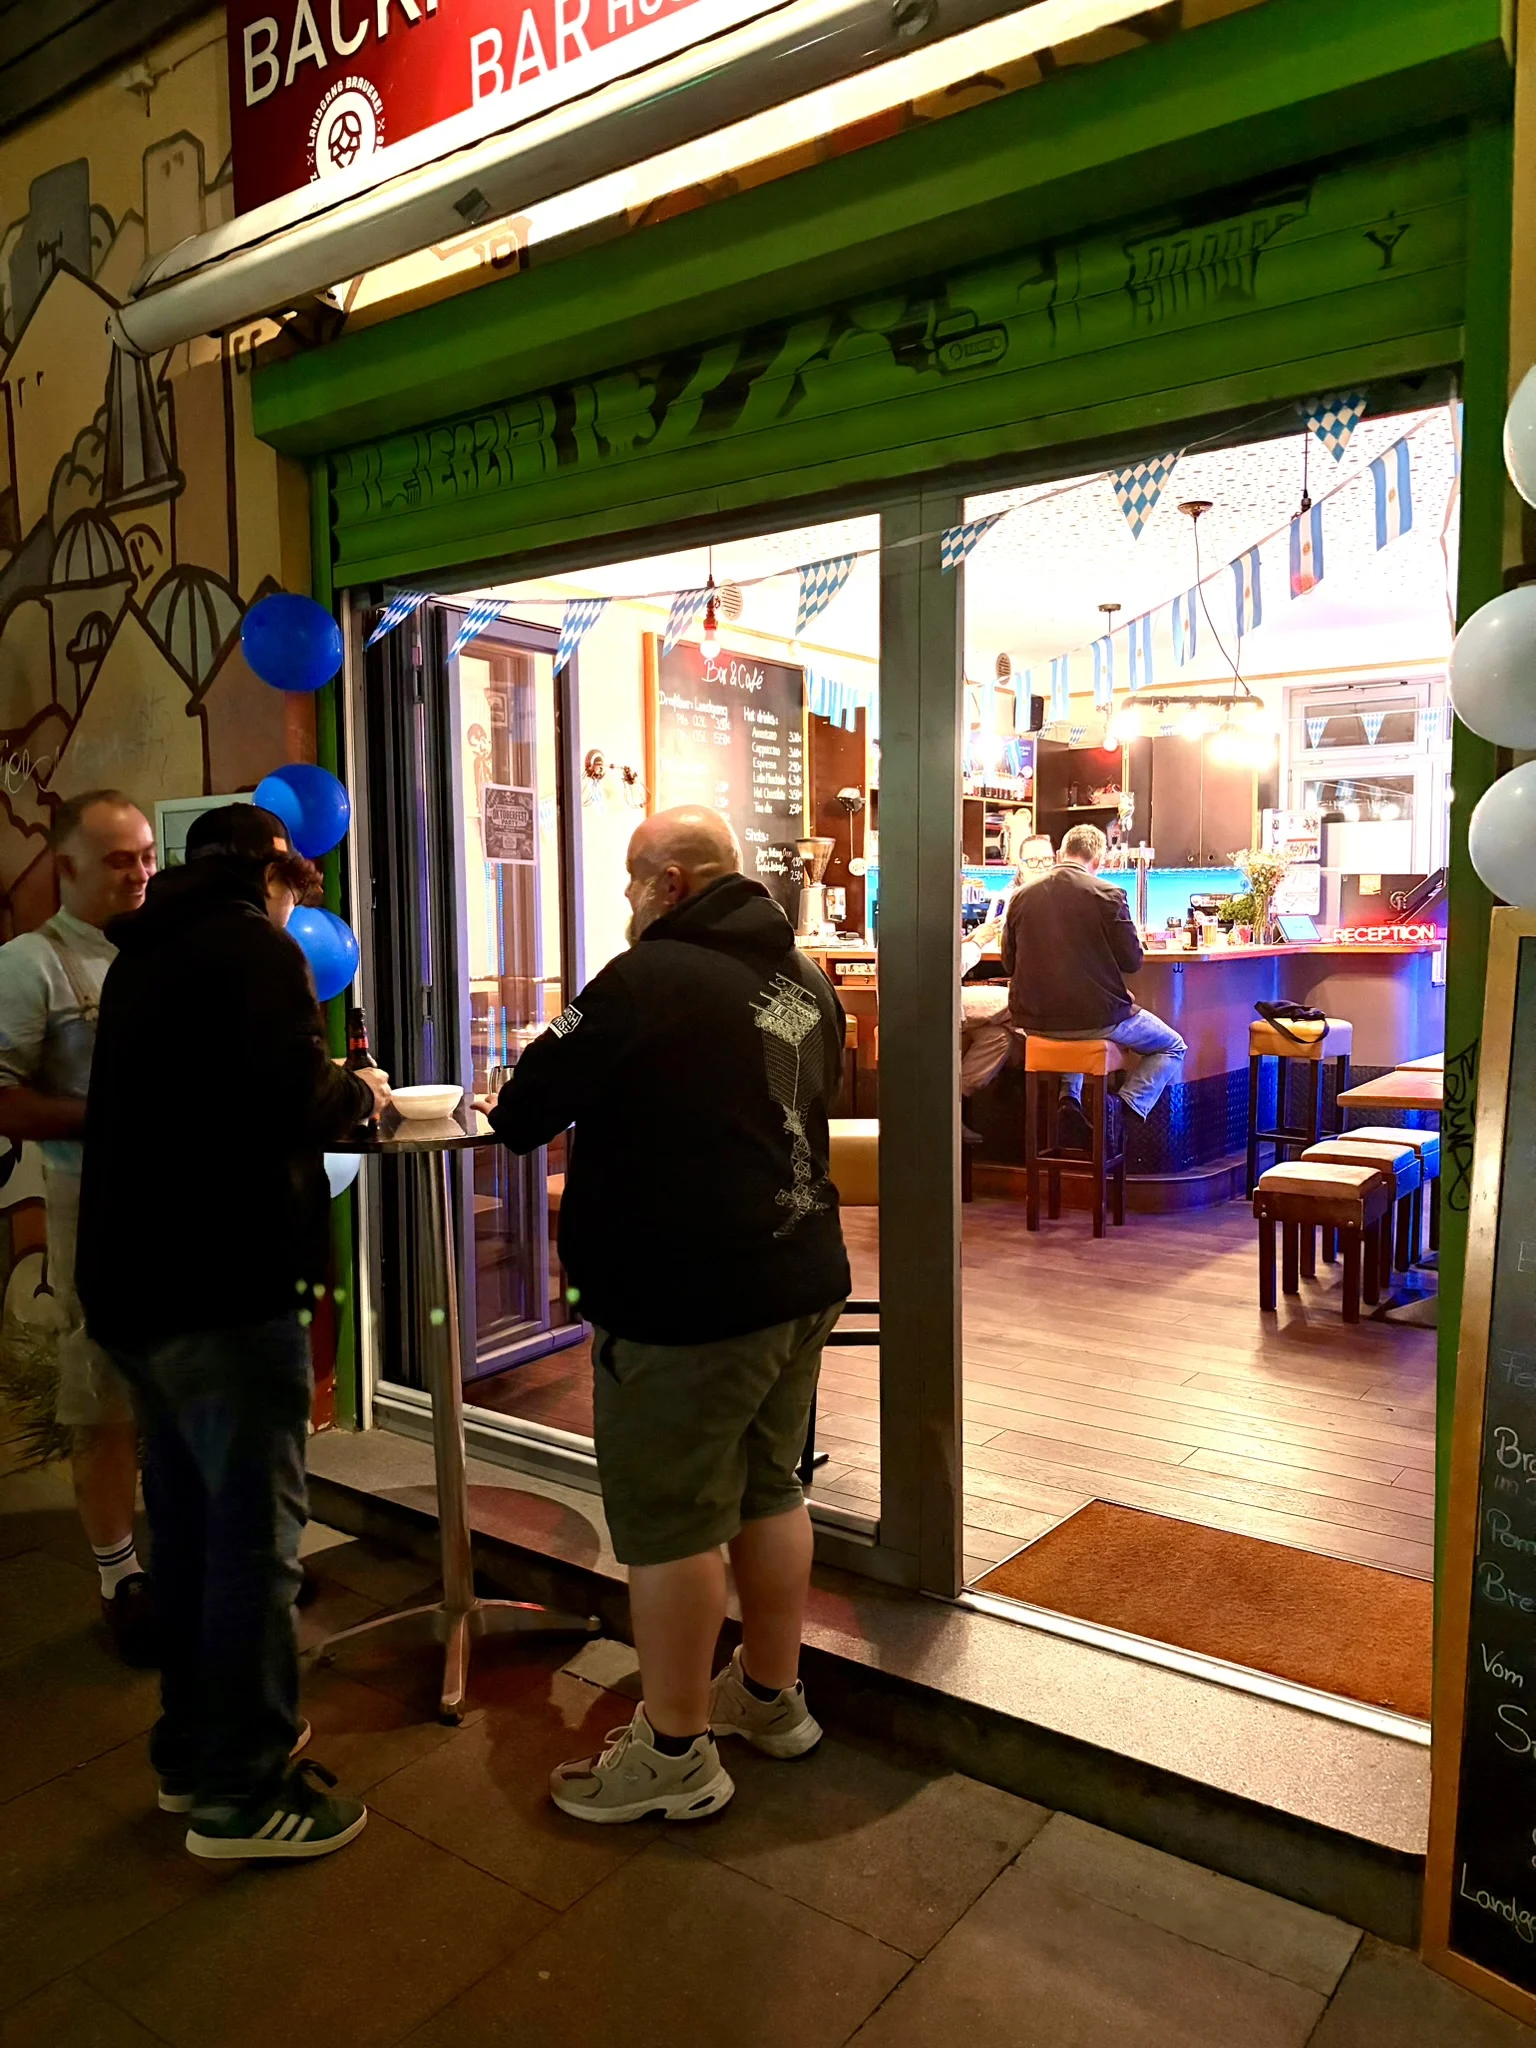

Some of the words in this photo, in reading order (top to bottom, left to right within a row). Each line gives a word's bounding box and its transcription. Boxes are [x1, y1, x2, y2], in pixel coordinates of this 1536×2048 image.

[470, 0, 592, 107] BAR
[306, 79, 344, 148] LANDGANG
[345, 75, 384, 116] BRAUEREI
[701, 658, 728, 686] Bar
[738, 664, 765, 693] Café
[743, 705, 756, 722] Hot
[753, 757, 777, 772] Espresso
[1333, 924, 1435, 942] RECEPTION
[1481, 1642, 1524, 1689] Vom
